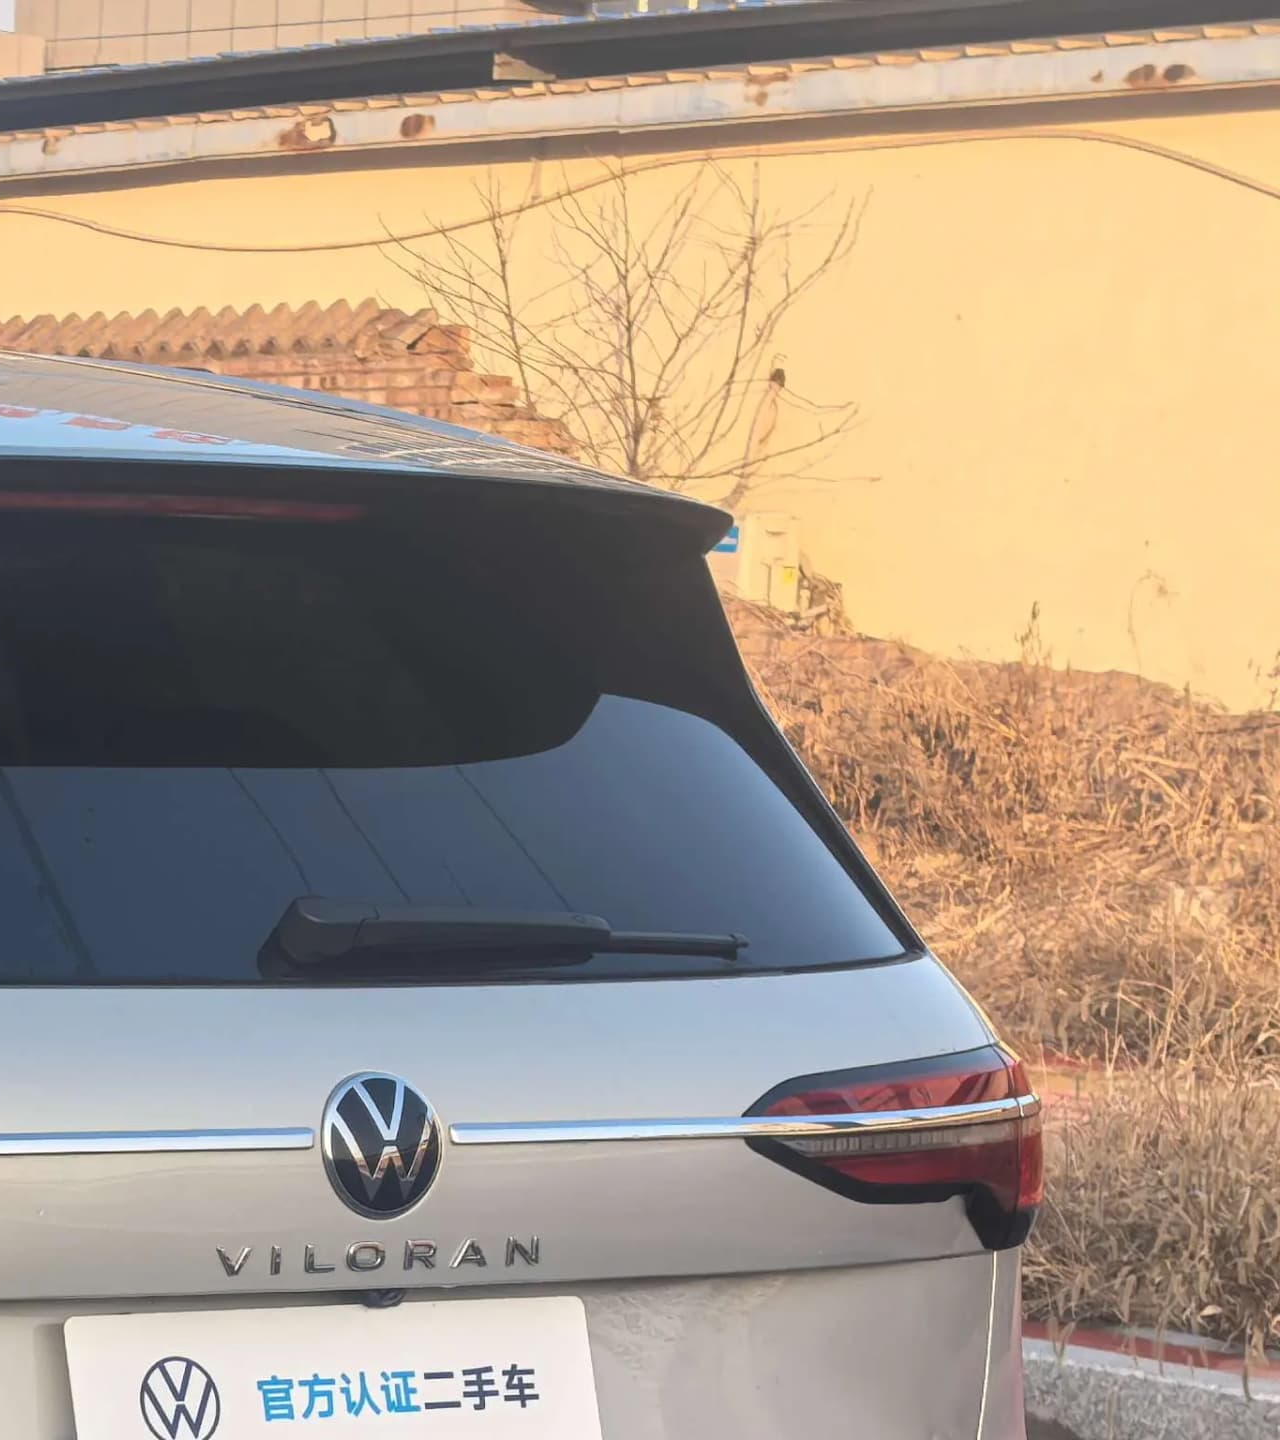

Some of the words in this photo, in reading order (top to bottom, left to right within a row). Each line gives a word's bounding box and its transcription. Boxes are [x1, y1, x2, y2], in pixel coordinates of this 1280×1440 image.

[216, 1234, 541, 1277] VILORAN
[256, 1363, 540, 1422] 官方认证二手车
